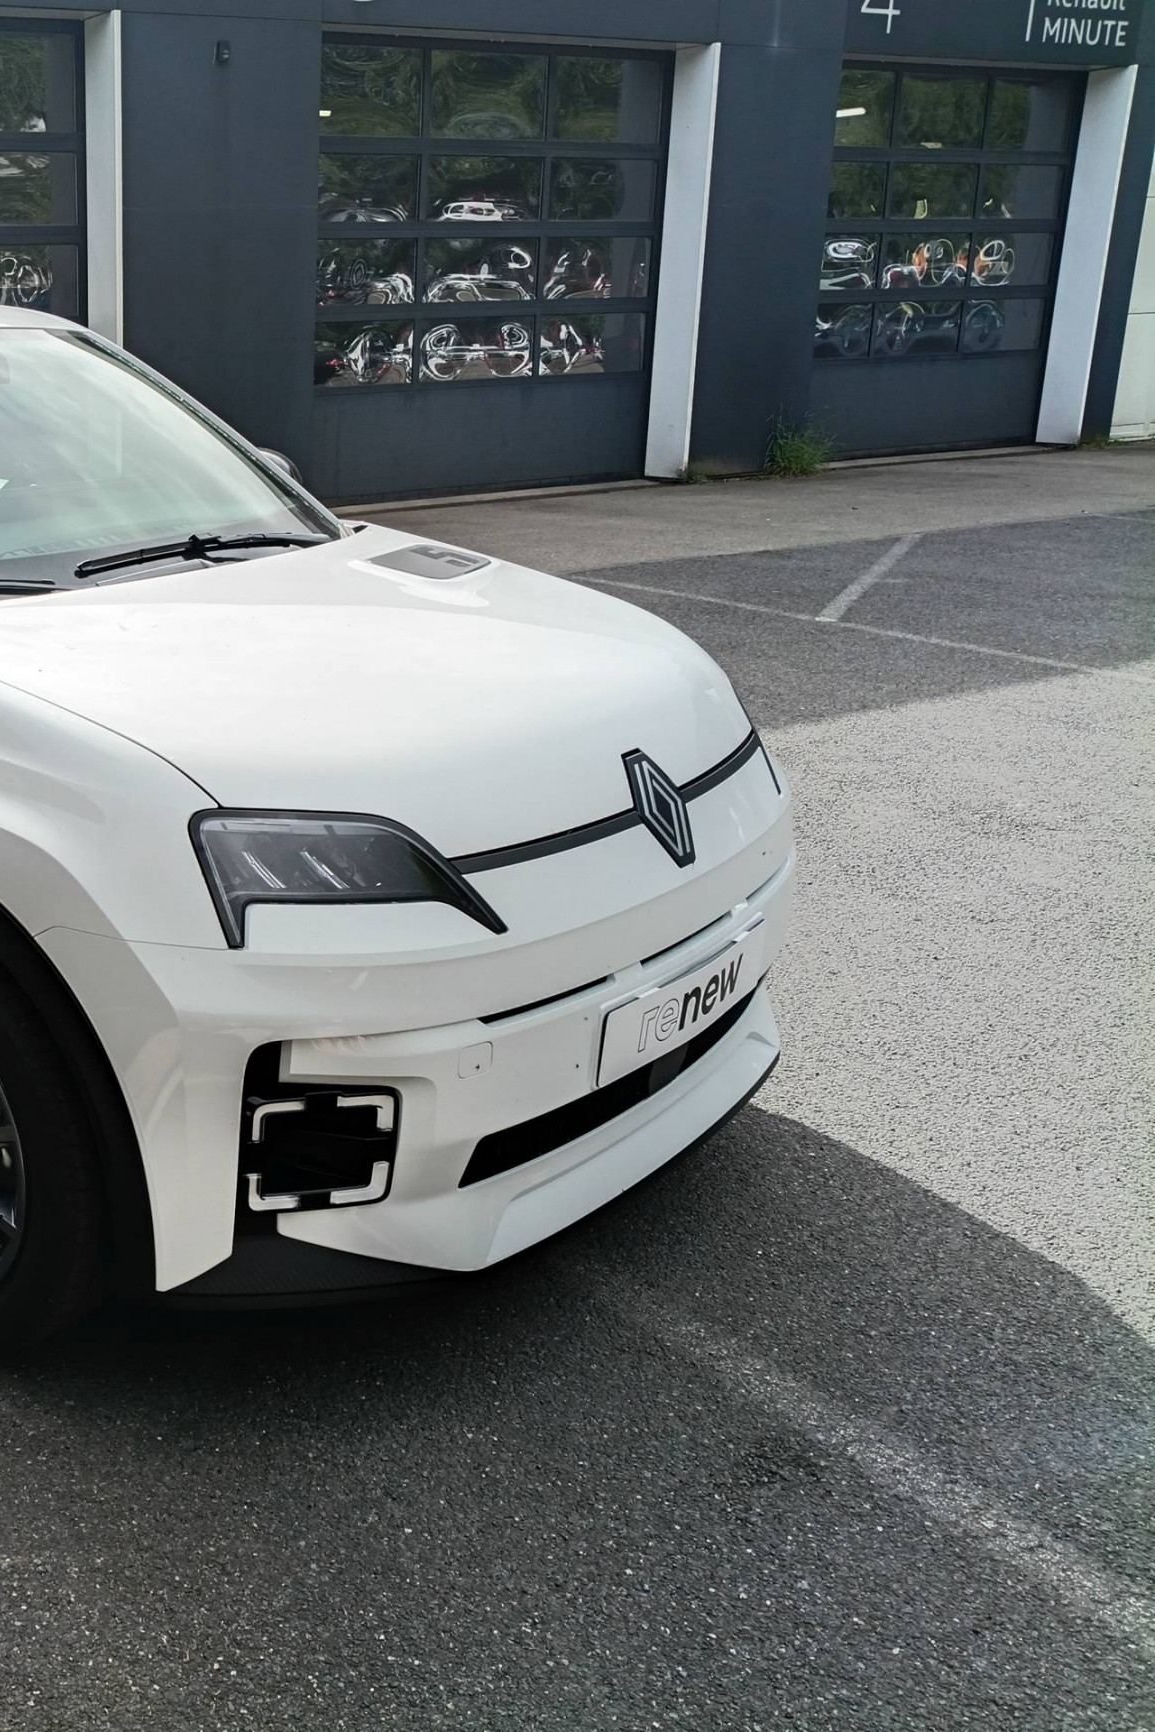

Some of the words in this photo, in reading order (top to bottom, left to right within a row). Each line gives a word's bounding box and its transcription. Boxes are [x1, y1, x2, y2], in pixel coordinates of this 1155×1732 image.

[1047, 0, 1126, 10] enault
[1042, 17, 1129, 46] MINUTE
[637, 952, 744, 1053] renew
